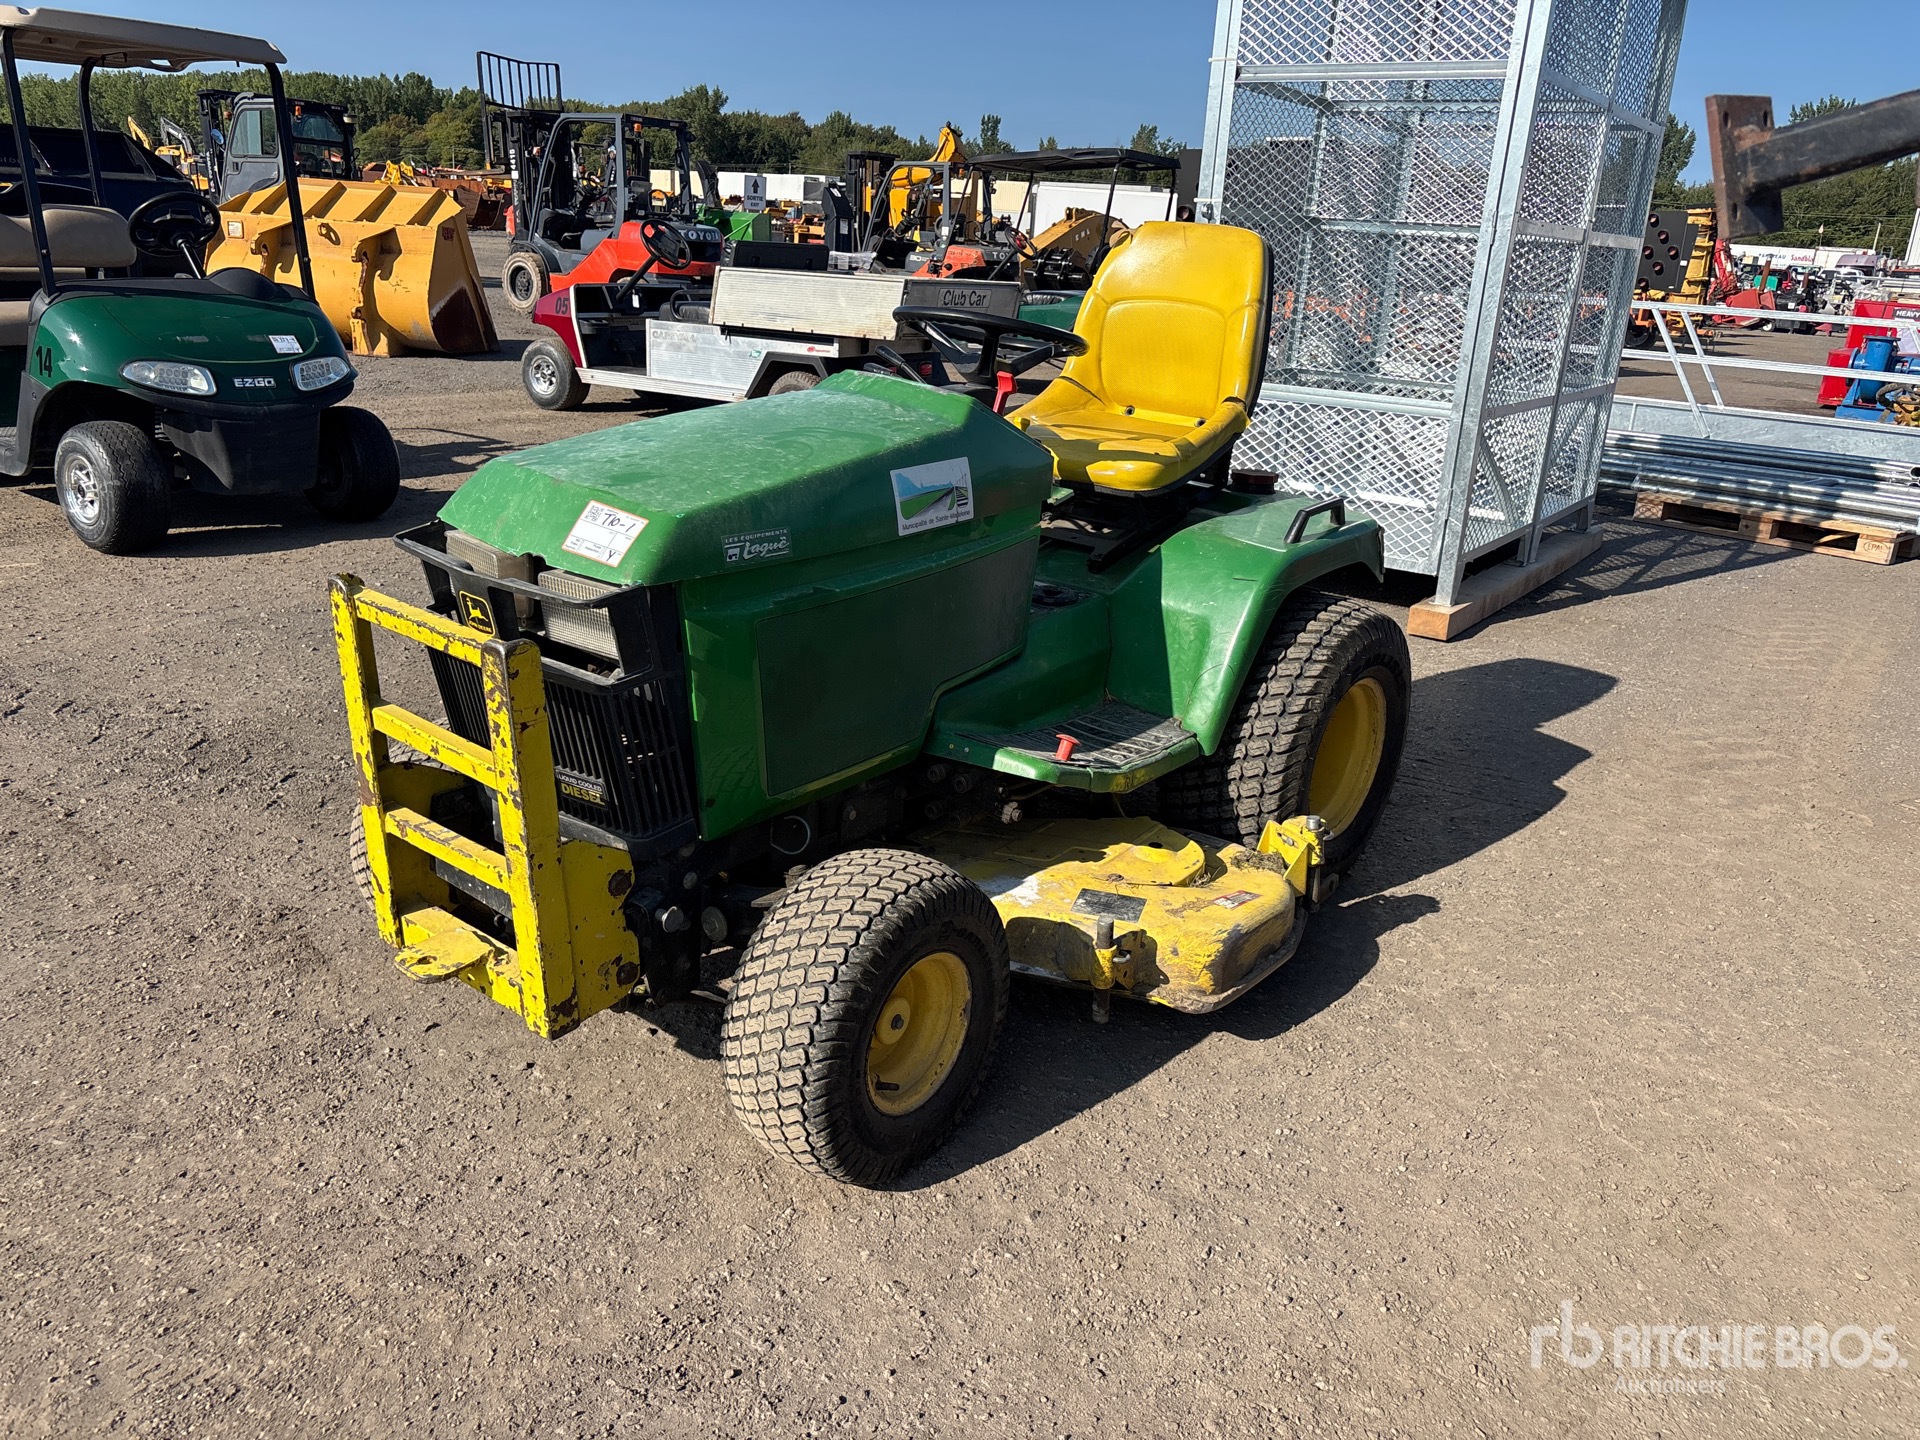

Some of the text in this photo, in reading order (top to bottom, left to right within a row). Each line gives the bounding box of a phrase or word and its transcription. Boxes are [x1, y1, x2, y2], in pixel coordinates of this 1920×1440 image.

[746, 194, 764, 202] SORTIE
[555, 297, 569, 315] 05
[943, 290, 987, 306] Club Car
[1896, 310, 1920, 318] HEAVY
[35, 345, 53, 379] 14
[578, 780, 602, 791] COOLED
[561, 783, 605, 805] DIESEL
